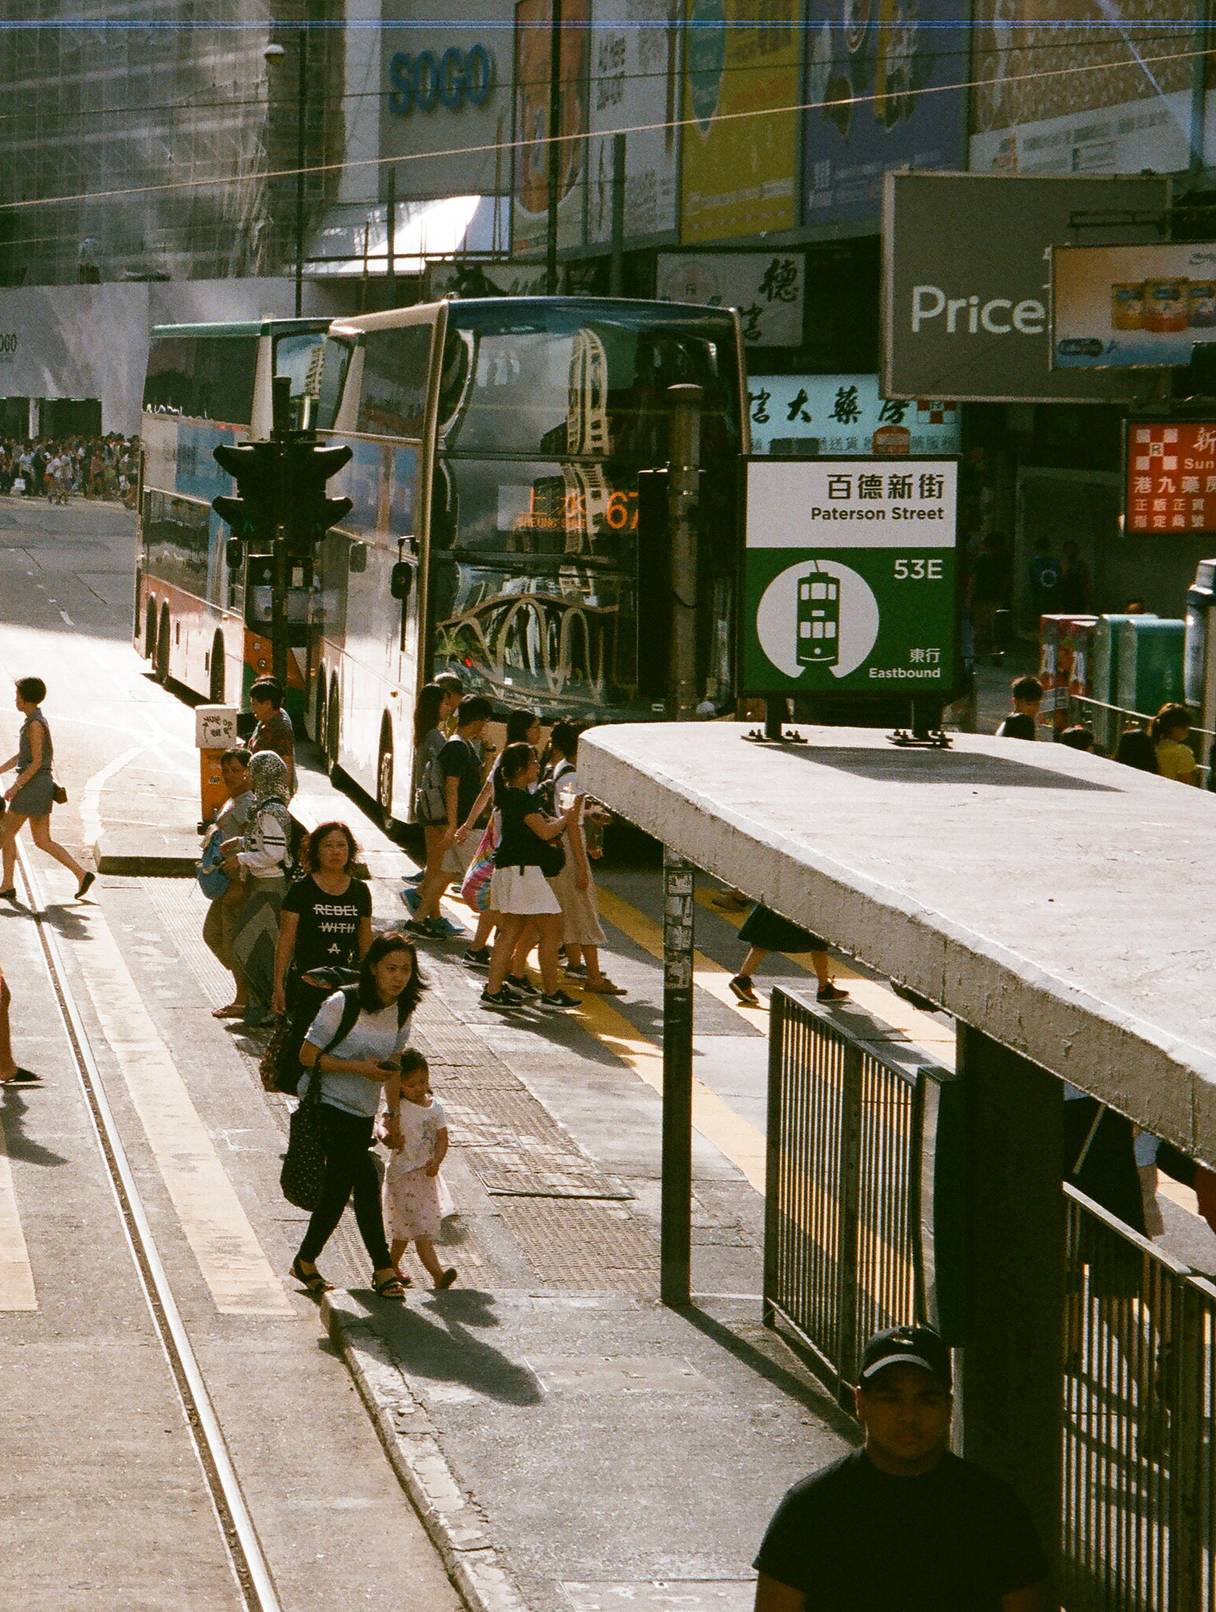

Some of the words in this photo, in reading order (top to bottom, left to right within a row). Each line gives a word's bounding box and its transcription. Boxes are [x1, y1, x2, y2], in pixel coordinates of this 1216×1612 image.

[388, 44, 490, 113] SOGO
[1184, 458, 1215, 469] Sun
[827, 473, 944, 499] 百德新街
[811, 507, 885, 520] Paterson
[892, 507, 944, 520] Street
[894, 559, 944, 580] 53E
[910, 648, 941, 663] 東行
[869, 667, 941, 678] Eastbound
[312, 904, 359, 916] REBEL
[319, 922, 356, 933] WITH
